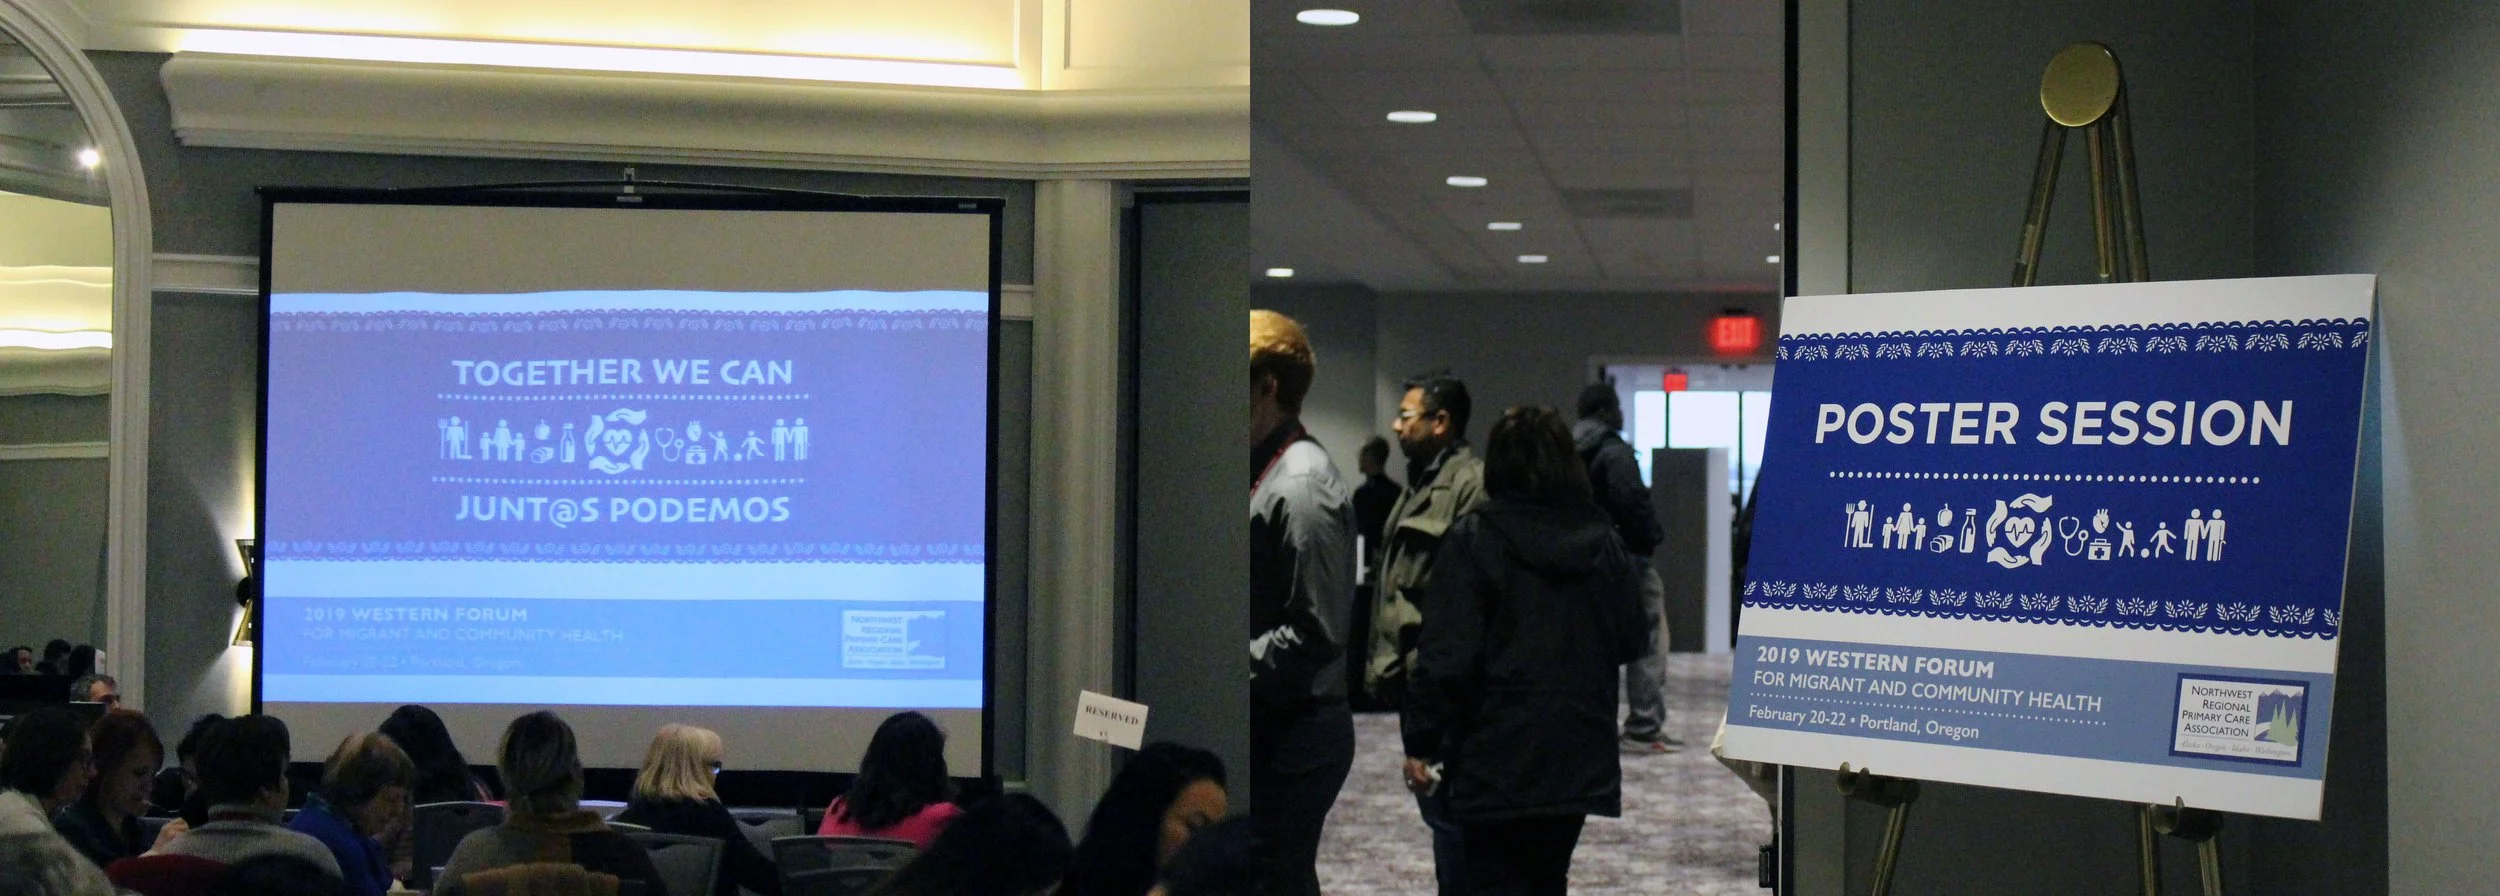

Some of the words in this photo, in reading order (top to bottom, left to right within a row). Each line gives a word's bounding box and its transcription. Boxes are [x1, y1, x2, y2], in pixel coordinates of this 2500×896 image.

[452, 358, 643, 386] TOGETHER
[652, 359, 710, 385] WE
[720, 359, 792, 385] CAN
[1815, 402, 2020, 445] POSTER
[2036, 400, 2293, 446] SESSION
[455, 496, 599, 528] JUNT@S
[610, 496, 790, 523] PODEMOS
[304, 607, 345, 621] 2019
[352, 607, 449, 621] WESTERN
[455, 607, 527, 622] FORUM
[302, 628, 334, 641] FOR
[416, 628, 450, 641] AND
[455, 628, 555, 641] COMMUNITY
[562, 629, 624, 642] HEALTH
[1757, 645, 1800, 664] 2019
[1806, 649, 1908, 673] WESTERN
[1914, 657, 1994, 679] FORUM
[1753, 670, 1785, 687] FOR
[1789, 673, 1865, 693] MIGRANT
[1868, 679, 1907, 696] AND
[1912, 683, 2024, 706] COMMUNITY
[2028, 691, 2102, 712] HEALTH
[2191, 686, 2253, 699] NORTHWEST
[1085, 705, 1139, 725] RESERVED
[2202, 699, 2251, 712] REGIONAL
[1749, 704, 1806, 726] February
[1809, 710, 1846, 726] 20-22
[1860, 714, 1921, 736] Portland,
[1926, 720, 1979, 741] Oregon
[2182, 710, 2222, 722] PRIMARY
[2224, 713, 2250, 725] CARE
[2184, 723, 2249, 737] ASSOCIATION
